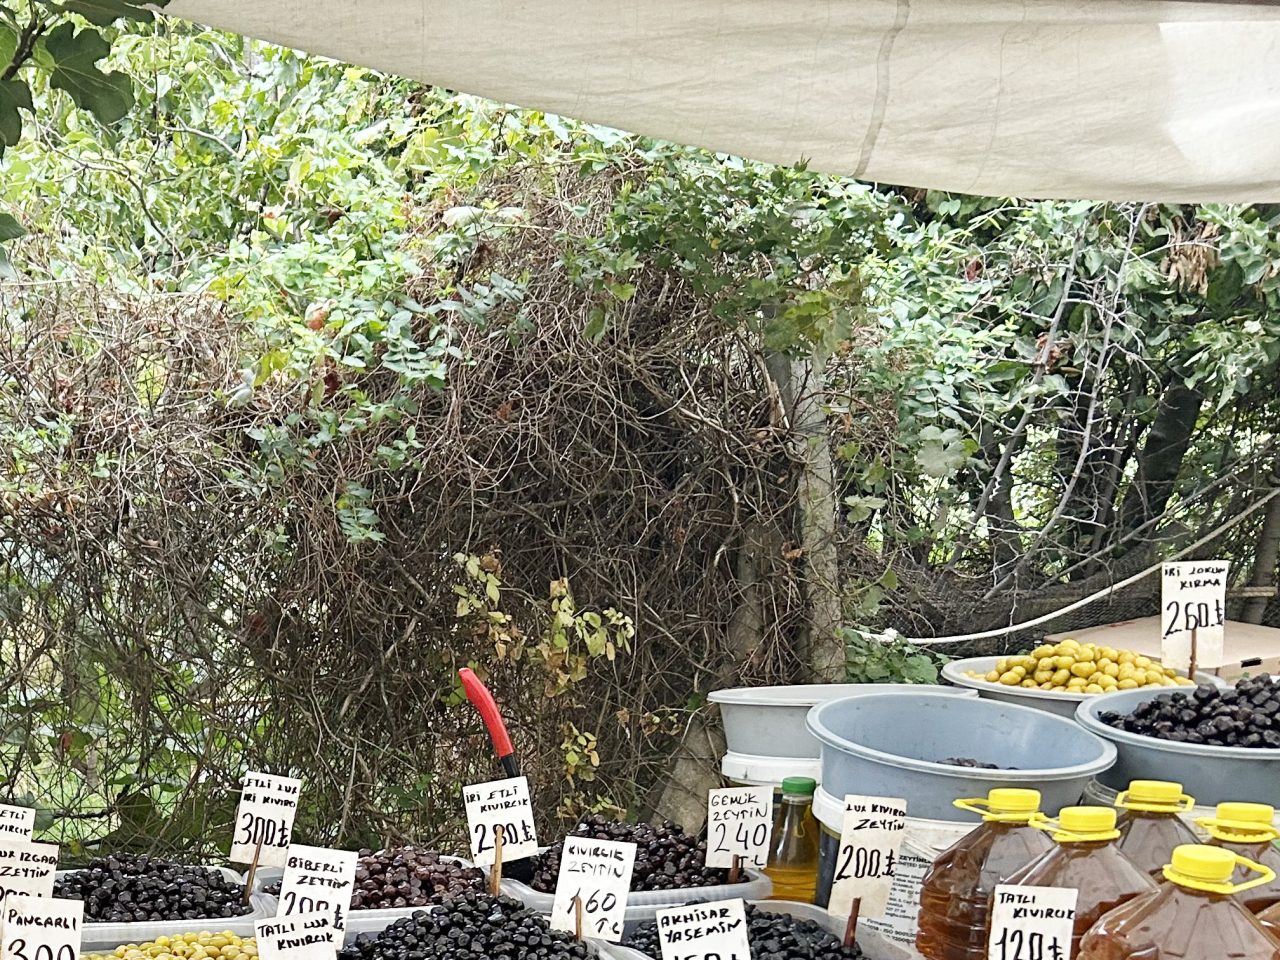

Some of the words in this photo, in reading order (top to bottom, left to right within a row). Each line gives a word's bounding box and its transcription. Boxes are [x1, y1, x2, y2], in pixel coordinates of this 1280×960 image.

[1180, 578, 1221, 590] KIRMA
[487, 786, 518, 800] ETLİ
[711, 793, 759, 806] GEMLİK
[481, 798, 528, 813] KIVIRCIK
[0, 810, 27, 820] ETLİ
[714, 822, 767, 853] 240
[0, 866, 50, 878] ZEYTİN
[287, 857, 344, 873] BİBERLİ
[567, 888, 616, 914] 160
[998, 892, 1035, 904] TATLI
[9, 909, 76, 931] PANCARLI
[661, 908, 731, 928] AKHİSAR
[257, 923, 295, 938] TATLI
[664, 919, 742, 943] YASEMİN
